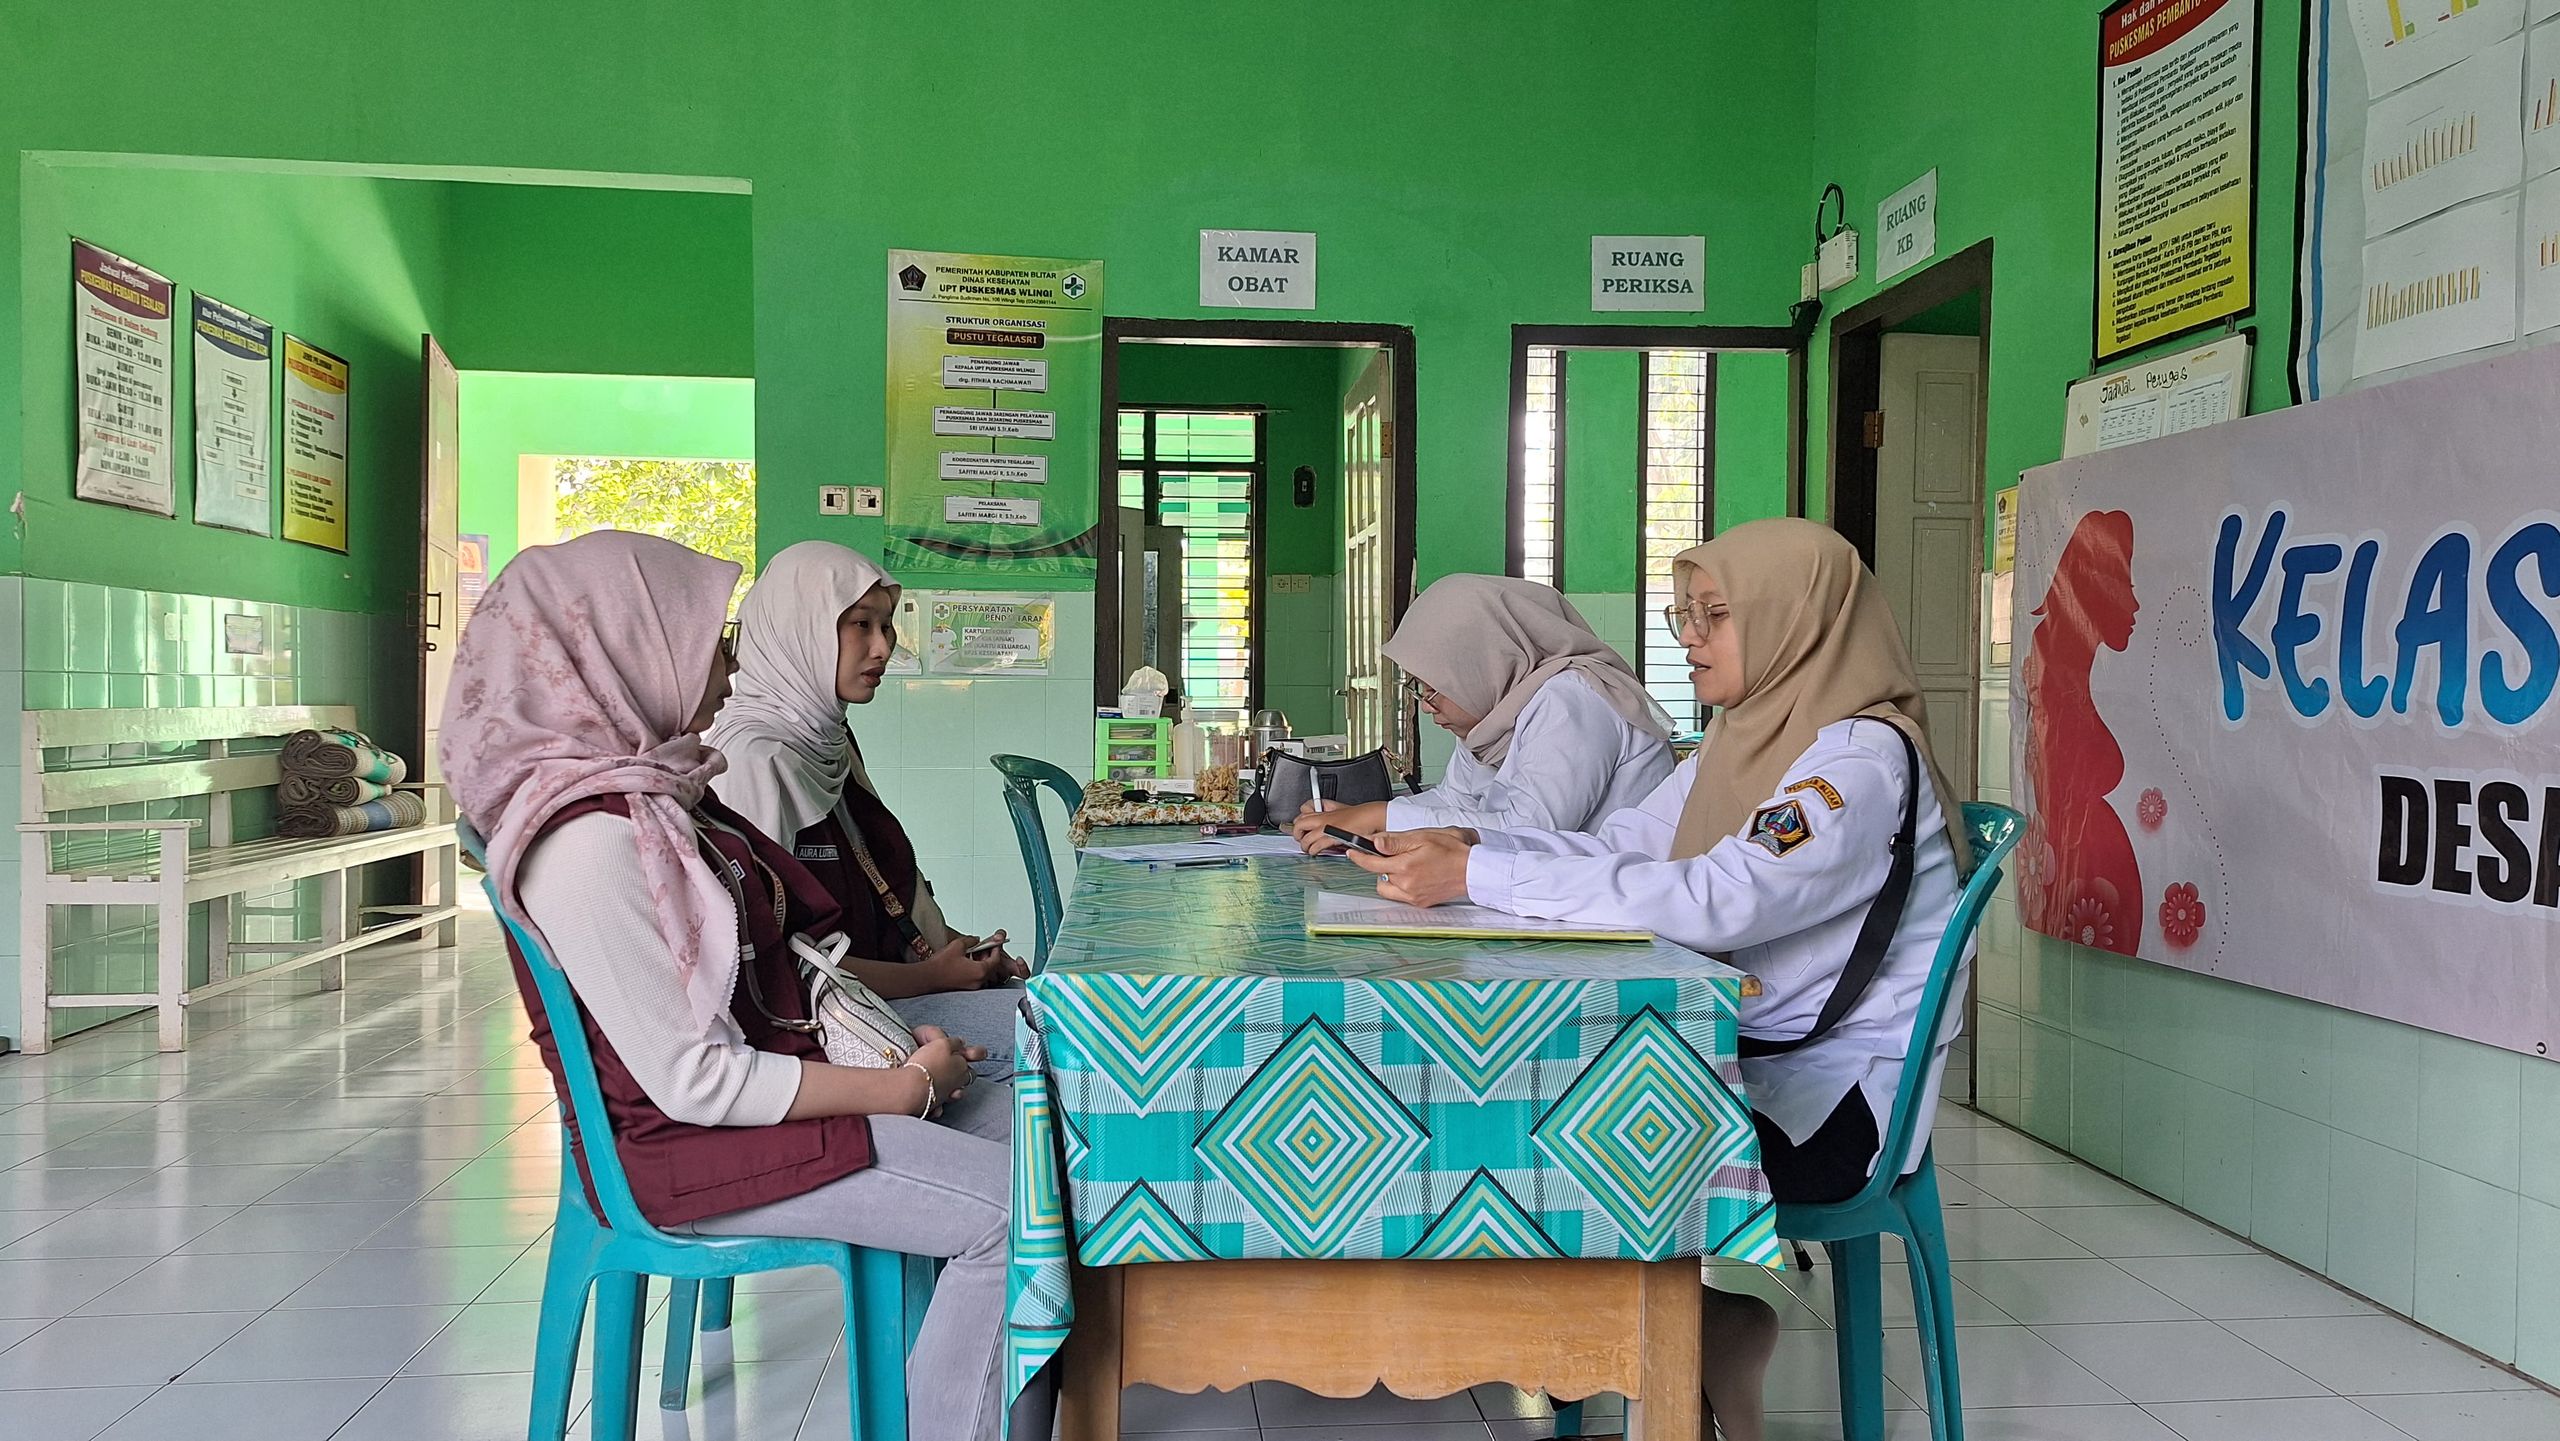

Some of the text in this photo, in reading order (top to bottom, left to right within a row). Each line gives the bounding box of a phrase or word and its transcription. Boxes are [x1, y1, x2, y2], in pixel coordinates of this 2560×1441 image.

[2121, 0, 2155, 28] Hak dan
[2109, 18, 2155, 60] PUSKESMAS
[1886, 193, 1928, 232] RUANG
[1897, 233, 1914, 256] KB
[1217, 246, 1299, 264] KAMAR
[1611, 251, 1684, 268] RUANG
[936, 266, 1057, 282] PEMERINTAH KABUPATEN BLITAR
[962, 276, 1031, 286] DINAS KESEHATAN
[939, 284, 958, 293] UPT
[959, 287, 1017, 297] PUSKESMAS
[1227, 276, 1288, 294] OBAT
[1602, 278, 1694, 295] PERIKSA
[946, 316, 1046, 329] STRUKTUR ORGANISASI
[86, 332, 100, 346] BUKA
[106, 326, 122, 341] SENIN
[127, 333, 143, 348] KAMIS
[954, 332, 1038, 345] PUSTU TEGALASRI
[2100, 367, 2188, 404] Jadwal Petugas
[953, 604, 1012, 613] PERSYARATAN
[2212, 510, 2560, 727] KELAS
[799, 847, 818, 858] AURA
